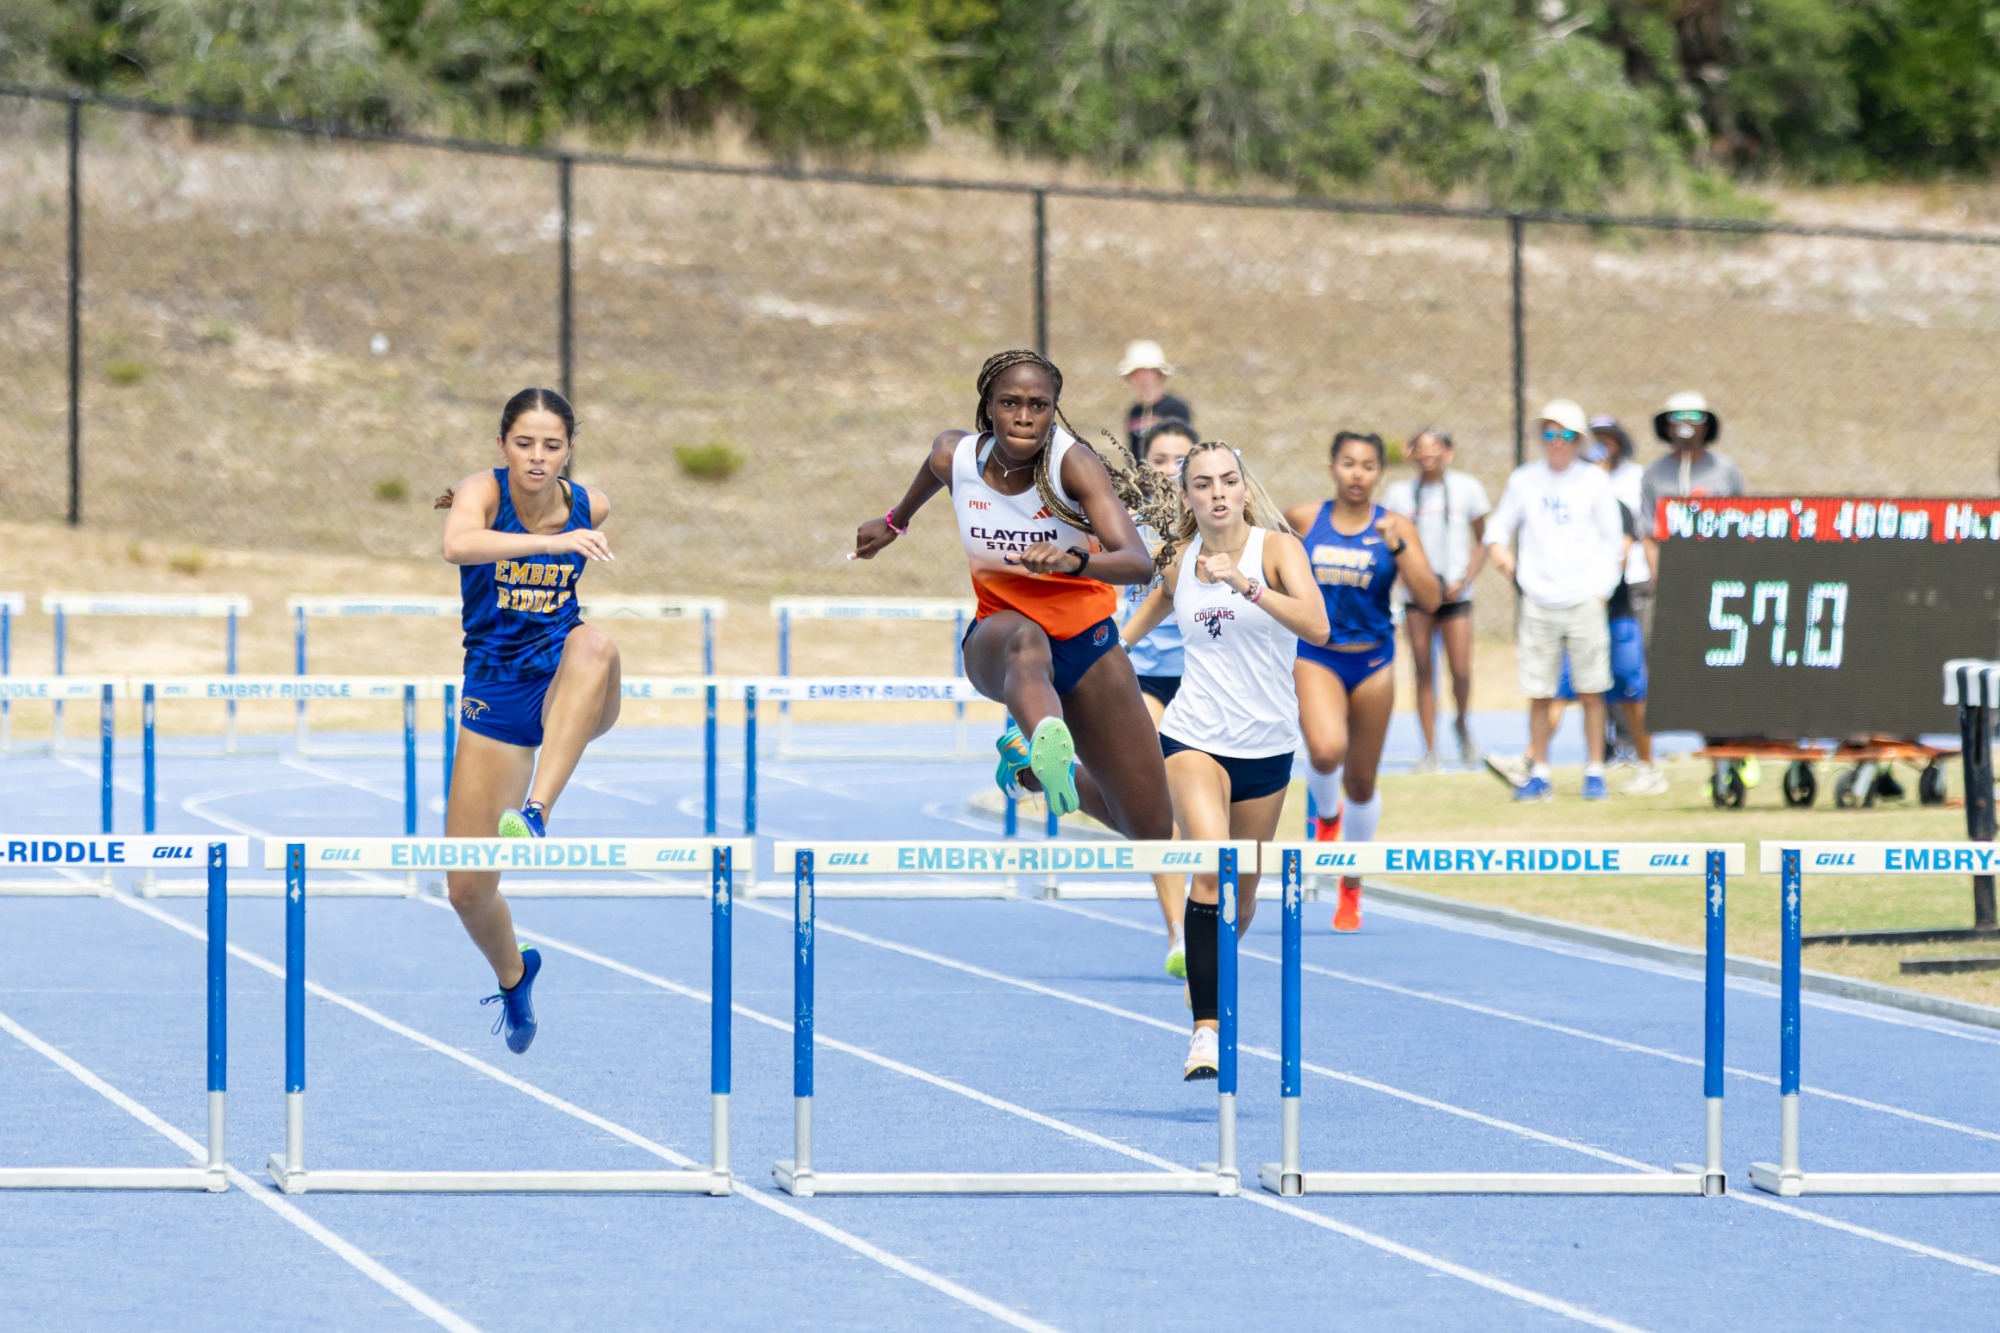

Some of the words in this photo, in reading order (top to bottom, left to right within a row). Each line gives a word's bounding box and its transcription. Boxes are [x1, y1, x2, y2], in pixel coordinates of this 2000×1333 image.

[968, 500, 991, 510] PBC
[1834, 501, 1929, 540] 400m
[970, 527, 1058, 542] CLAYTON
[986, 541, 1034, 552] STAT
[495, 561, 578, 587] EMBRY-
[497, 587, 571, 613] RIDDLE
[1194, 609, 1235, 623] COUGARS
[1705, 581, 1848, 669] 57.0
[152, 847, 194, 859] GILL
[321, 848, 361, 861] GILL
[391, 845, 627, 867] EMBRY-RIDDLE
[656, 849, 698, 862] GILL
[828, 853, 870, 865] GILL
[898, 848, 1134, 870] EMBRY-RIDDLE
[1162, 852, 1203, 865] GILL
[1315, 854, 1357, 866] GILL
[1386, 849, 1620, 871] EMBRY-RIDDLE
[1649, 854, 1690, 866] GILL
[1815, 853, 1856, 866] GILL
